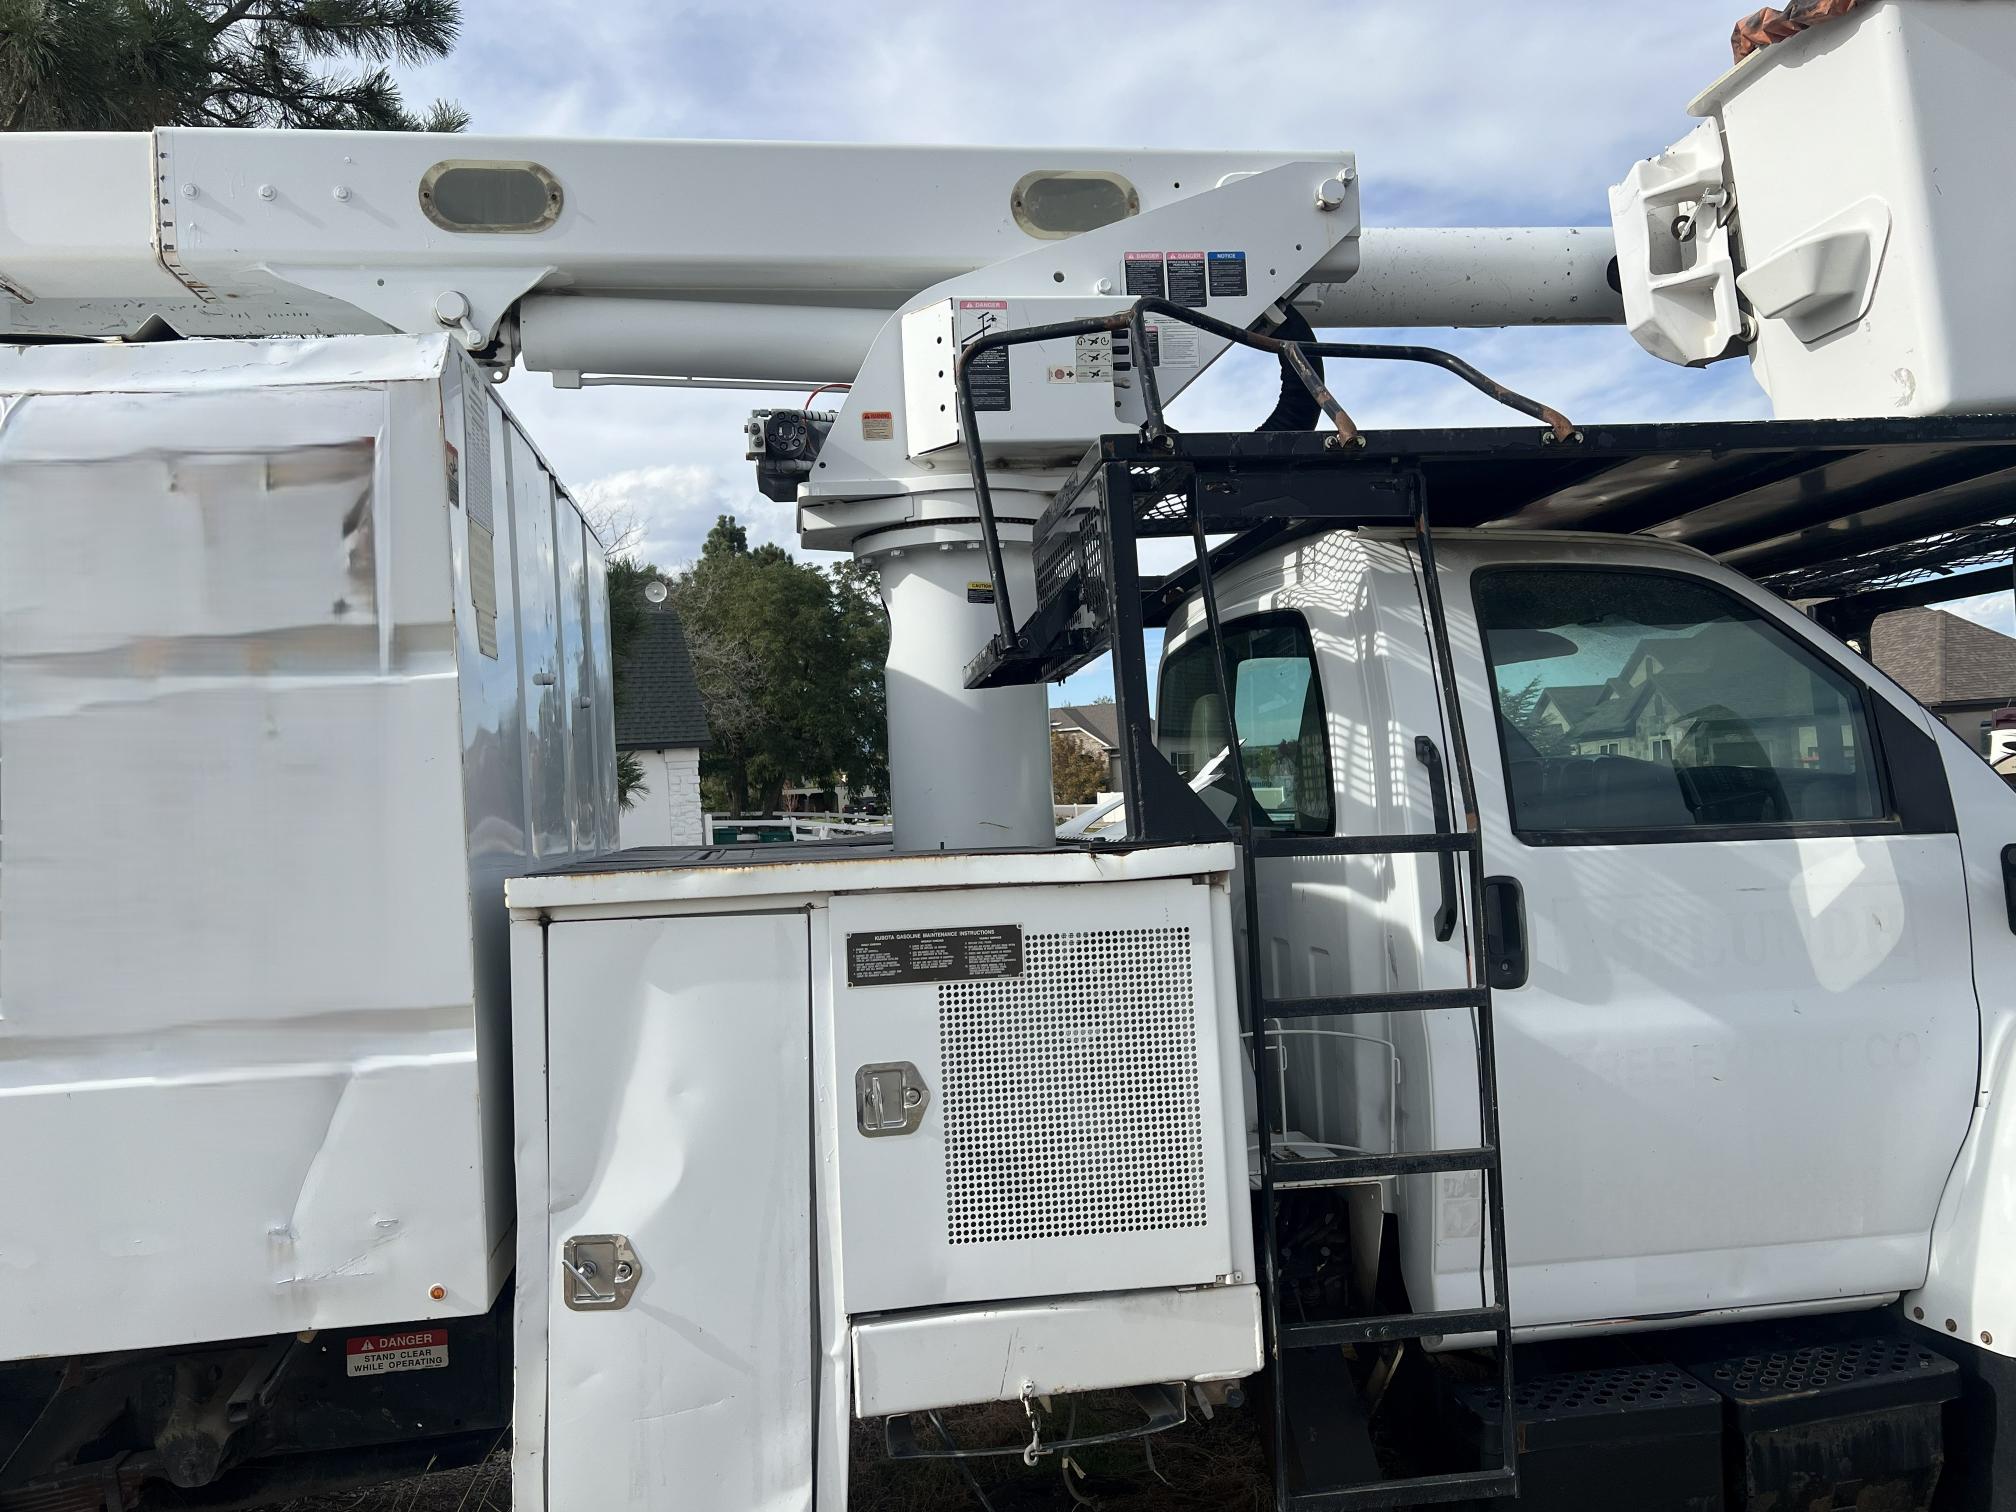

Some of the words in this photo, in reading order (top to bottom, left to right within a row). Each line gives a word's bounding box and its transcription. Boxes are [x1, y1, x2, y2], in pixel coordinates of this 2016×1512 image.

[922, 931, 958, 939] MAINTENANCE
[379, 1333, 433, 1348] DANGER
[364, 1352, 396, 1363] STAND
[400, 1349, 432, 1359] CLEAR
[354, 1362, 384, 1373] WHILE
[388, 1356, 443, 1369] OPERATING
